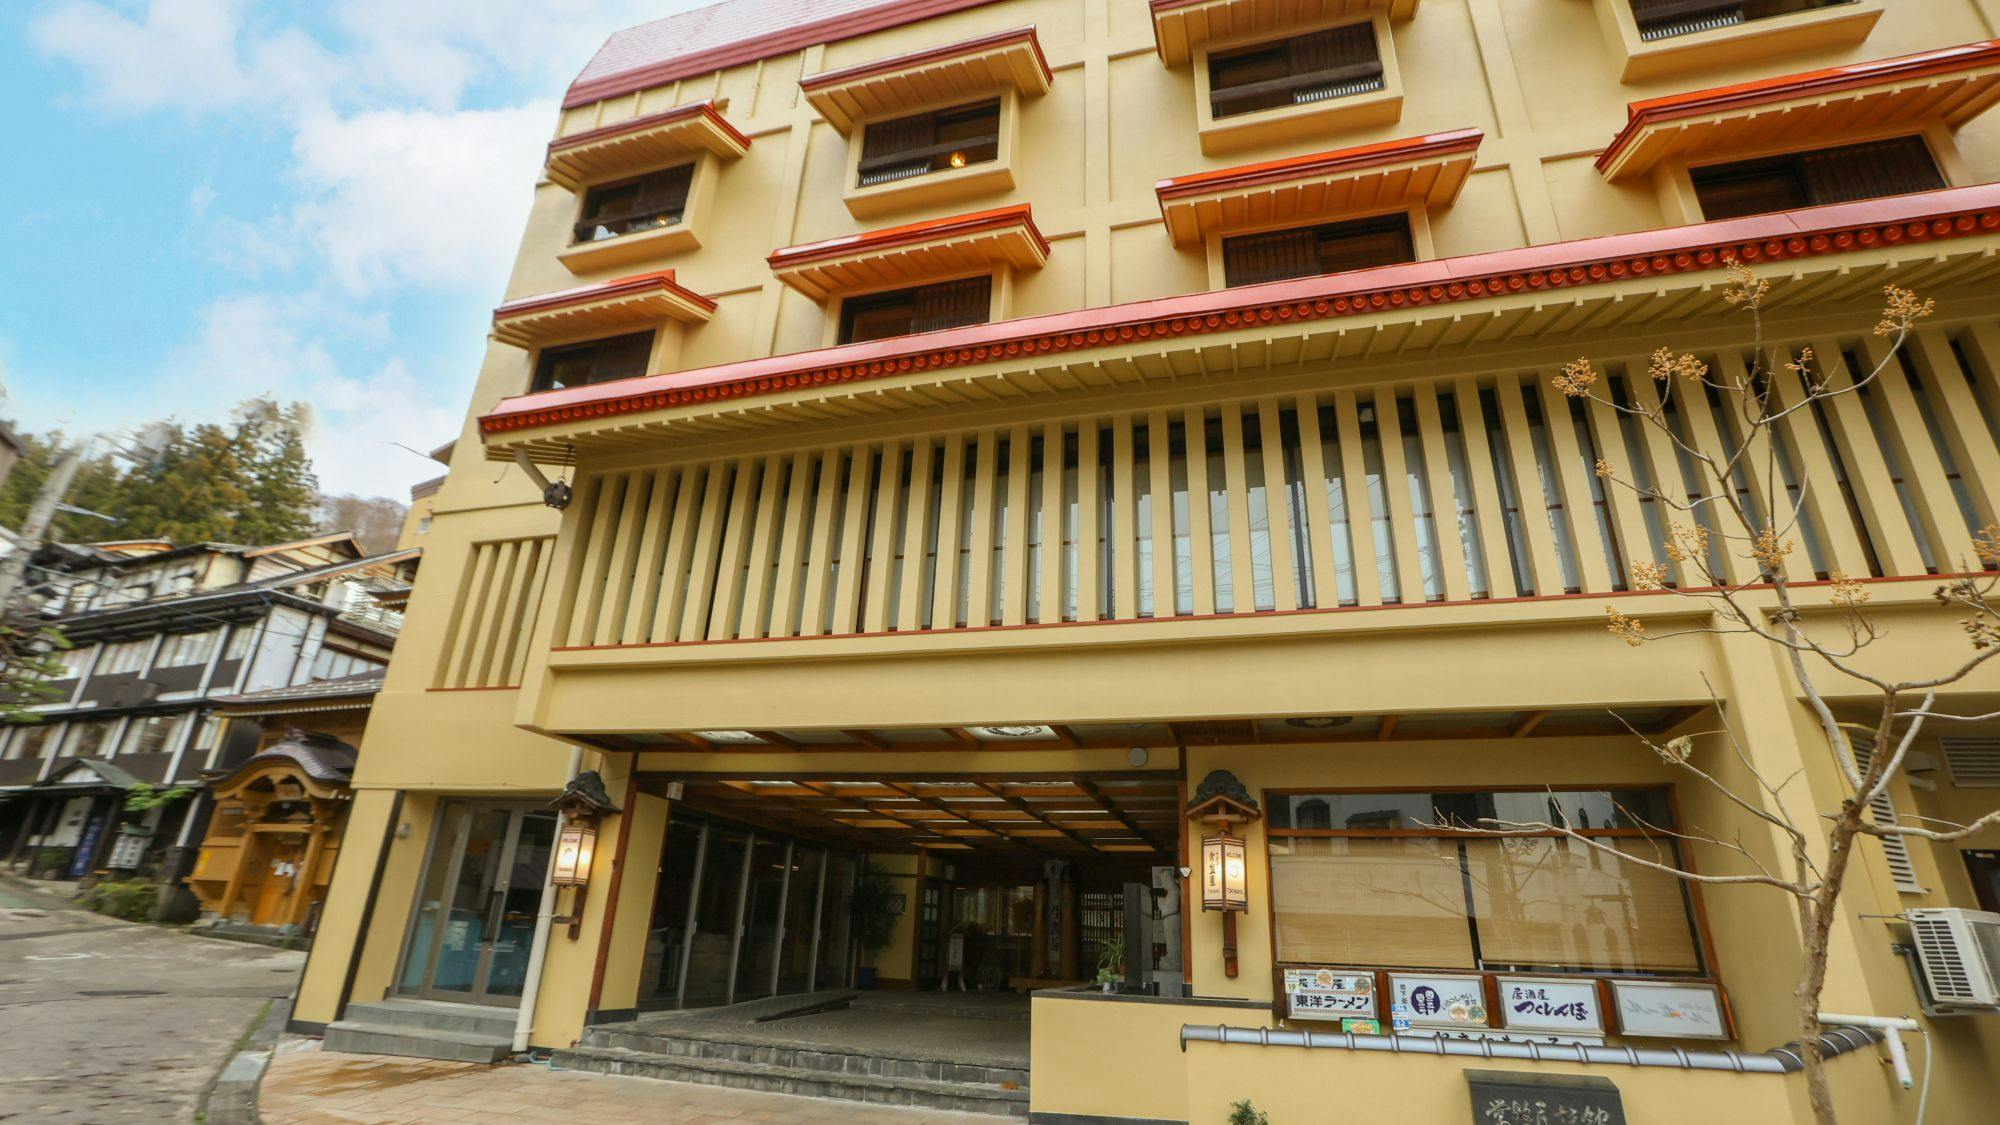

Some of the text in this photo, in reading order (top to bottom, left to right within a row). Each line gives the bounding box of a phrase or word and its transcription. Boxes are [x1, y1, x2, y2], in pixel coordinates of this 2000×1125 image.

[1295, 994, 1369, 1010] 東洋ラーメン
[1512, 987, 1549, 1001] 居酒屋
[1514, 1001, 1588, 1020] つくしんぼ
